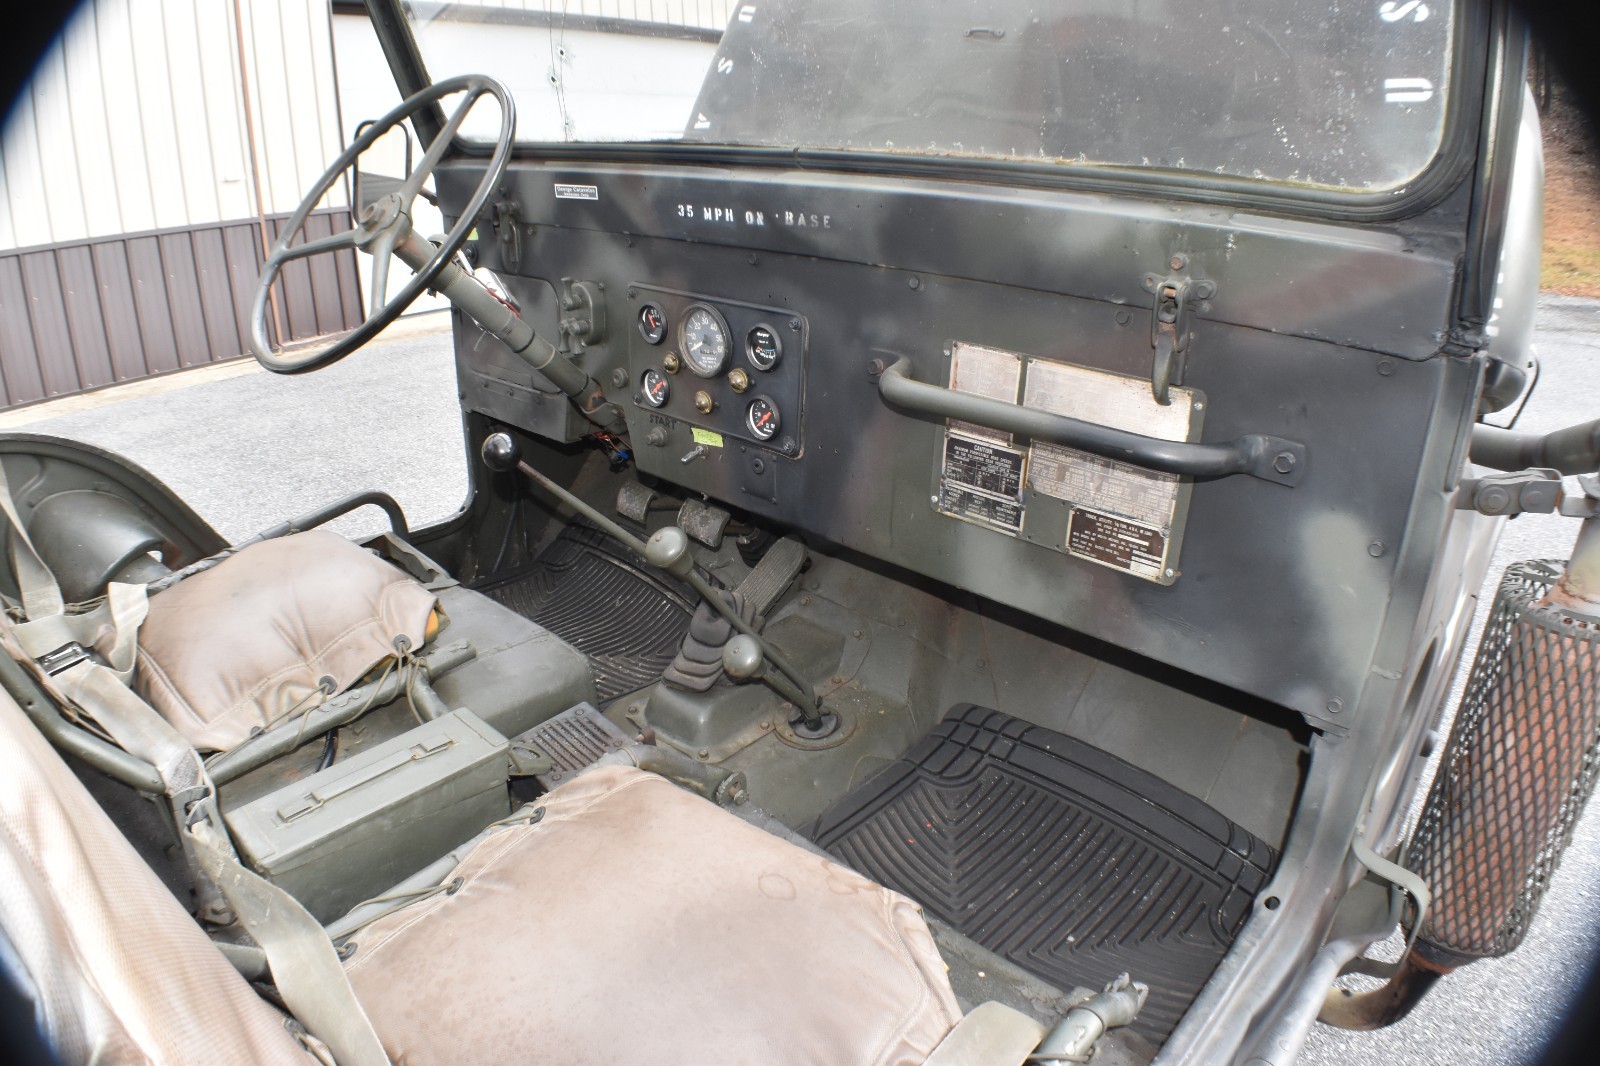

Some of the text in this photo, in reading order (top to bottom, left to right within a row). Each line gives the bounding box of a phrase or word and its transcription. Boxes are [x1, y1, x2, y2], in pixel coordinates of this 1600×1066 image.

[677, 204, 831, 229] 35 MPH ON BASE
[701, 316, 709, 325] 30
[710, 322, 718, 331] 40
[715, 334, 723, 342] 50
[649, 413, 677, 430] START
[973, 445, 993, 454] CAUTION
